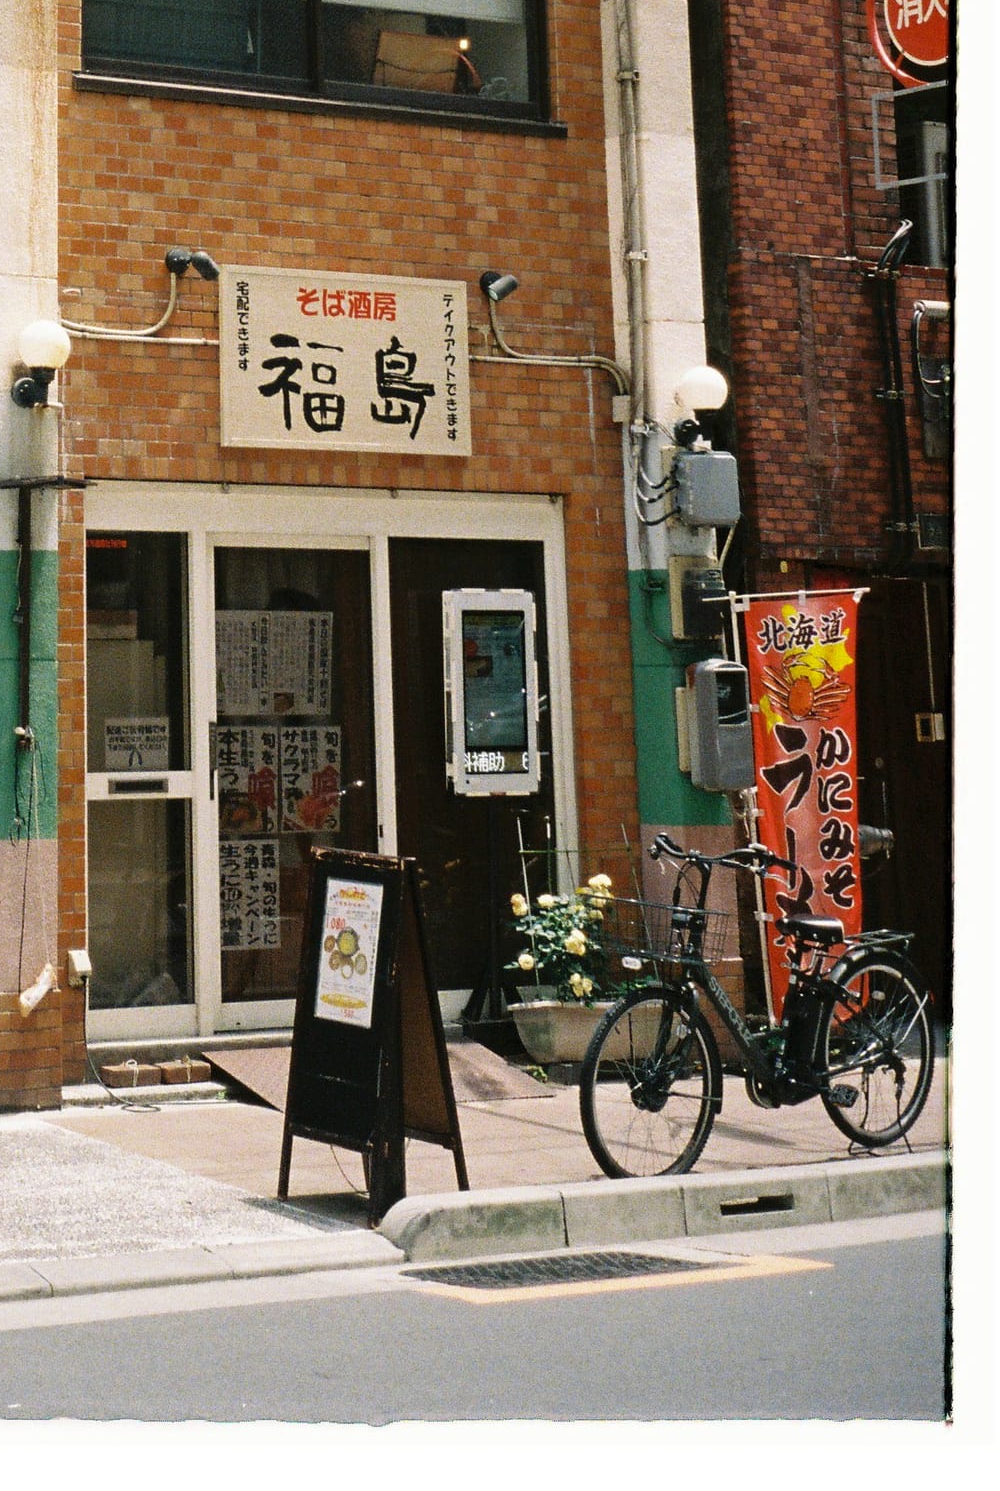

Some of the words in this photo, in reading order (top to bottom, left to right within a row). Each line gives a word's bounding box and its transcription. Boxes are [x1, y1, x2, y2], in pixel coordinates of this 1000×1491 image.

[236, 281, 249, 371] 宅配できます
[296, 287, 397, 322] そば酒房
[258, 333, 436, 439] 福島
[443, 293, 458, 441] テイクアウトできます
[757, 610, 846, 655] 北海道
[816, 726, 857, 908] かにみそ
